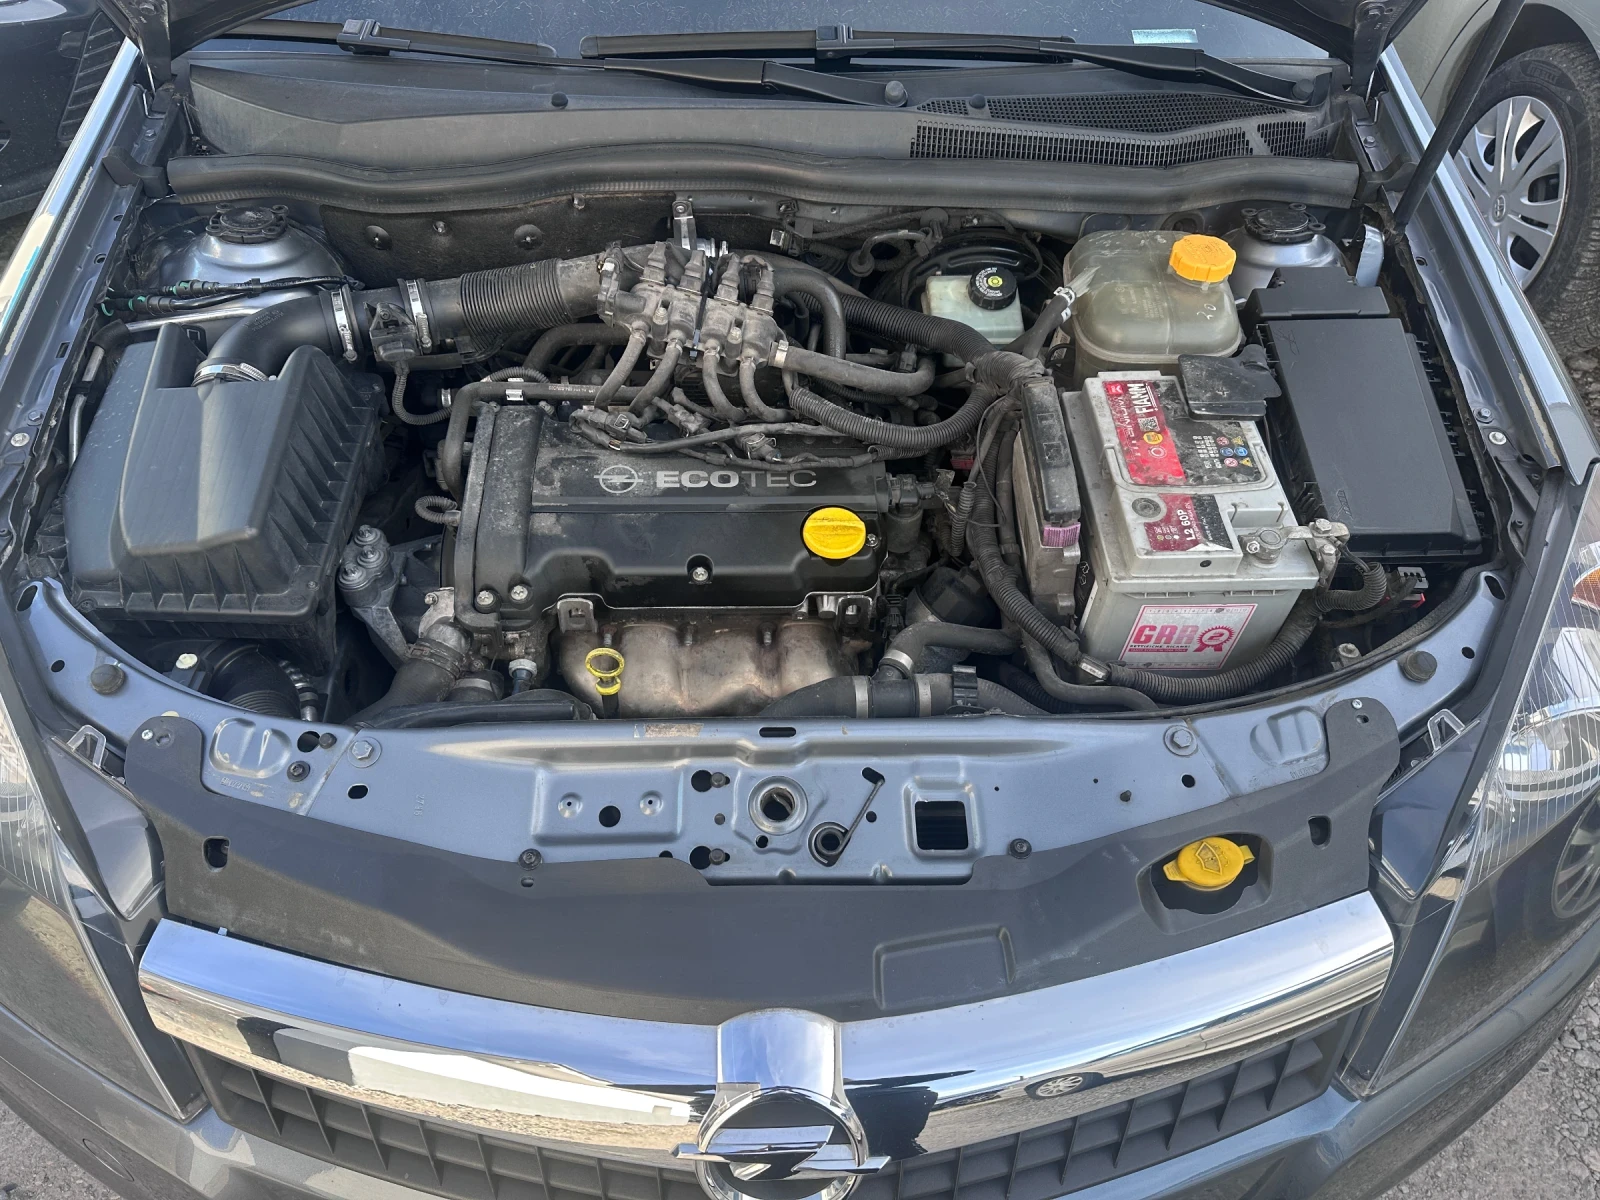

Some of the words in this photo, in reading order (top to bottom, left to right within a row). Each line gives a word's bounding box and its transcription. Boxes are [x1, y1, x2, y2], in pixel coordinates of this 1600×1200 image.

[1127, 383, 1154, 414] FIAMM
[656, 470, 817, 488] ECOTEC
[1177, 509, 1191, 527] 60P
[1184, 528, 1196, 541] L2
